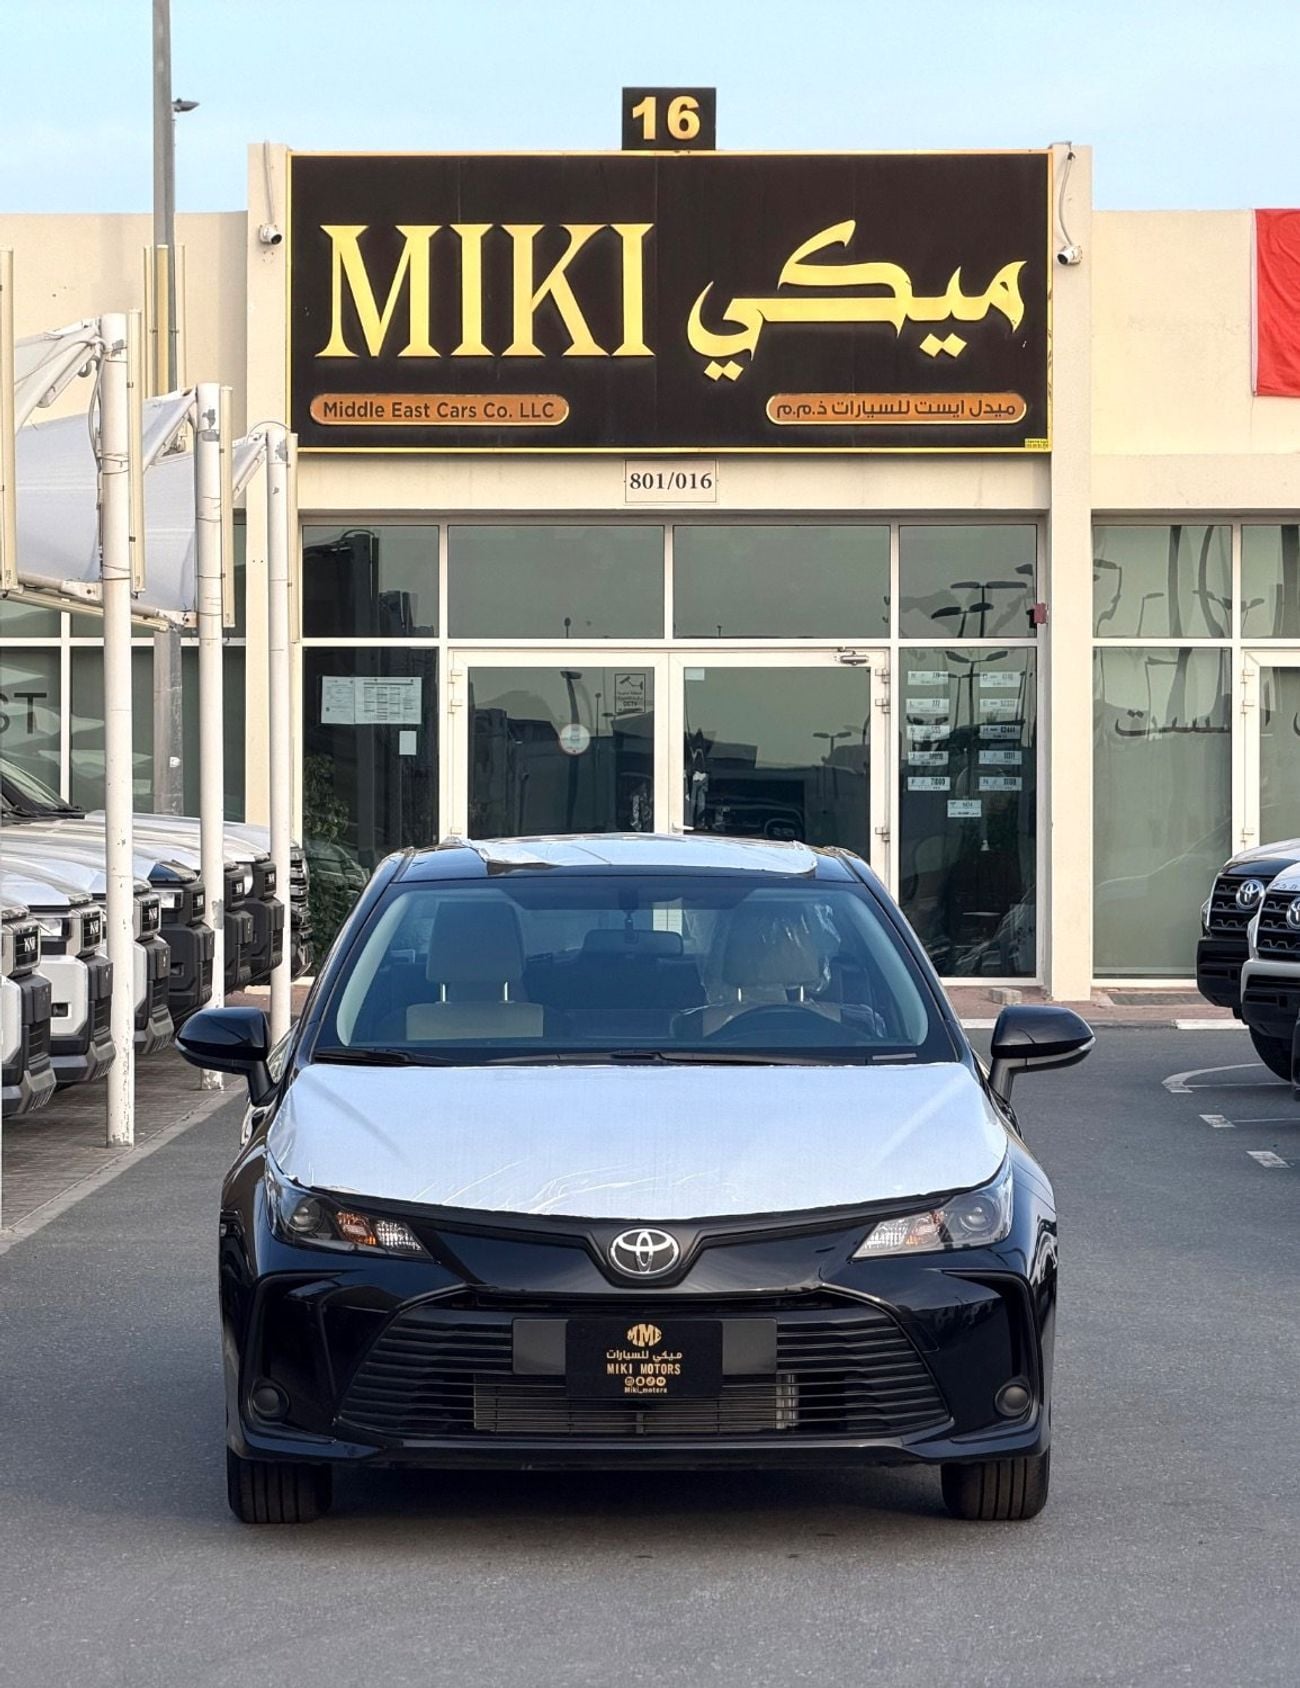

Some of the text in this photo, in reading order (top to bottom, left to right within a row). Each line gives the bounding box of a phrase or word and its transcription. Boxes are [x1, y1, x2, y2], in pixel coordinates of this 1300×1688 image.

[632, 96, 701, 140] 16
[315, 222, 655, 358] MIKI
[687, 220, 1028, 382] ميكي
[323, 401, 554, 418] Middle East Cars Co. LLC
[831, 400, 911, 418] للسيارات
[914, 400, 965, 418] ايست
[969, 400, 1016, 418] ميدل
[630, 472, 713, 491] 801/016
[606, 1349, 683, 1363] ميكي للسيارات
[606, 1363, 681, 1375] MIKI MOTORS
